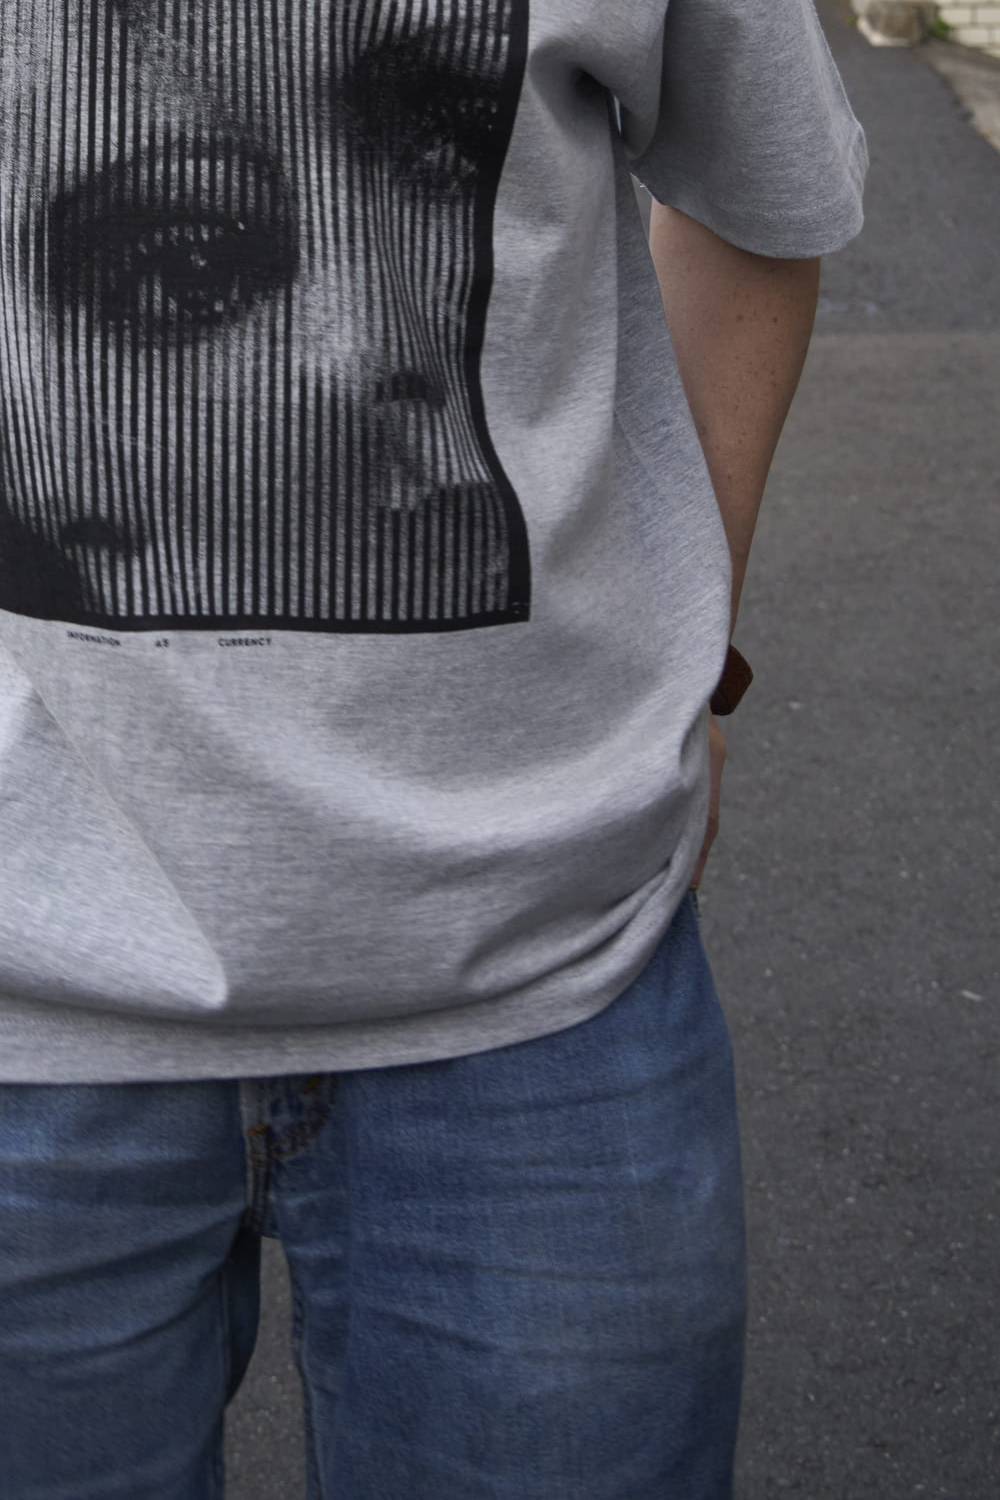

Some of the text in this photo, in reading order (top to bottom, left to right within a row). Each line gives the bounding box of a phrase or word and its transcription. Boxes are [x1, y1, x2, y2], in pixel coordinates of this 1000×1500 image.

[66, 630, 273, 648] INFORMATION AS CURRENCY
